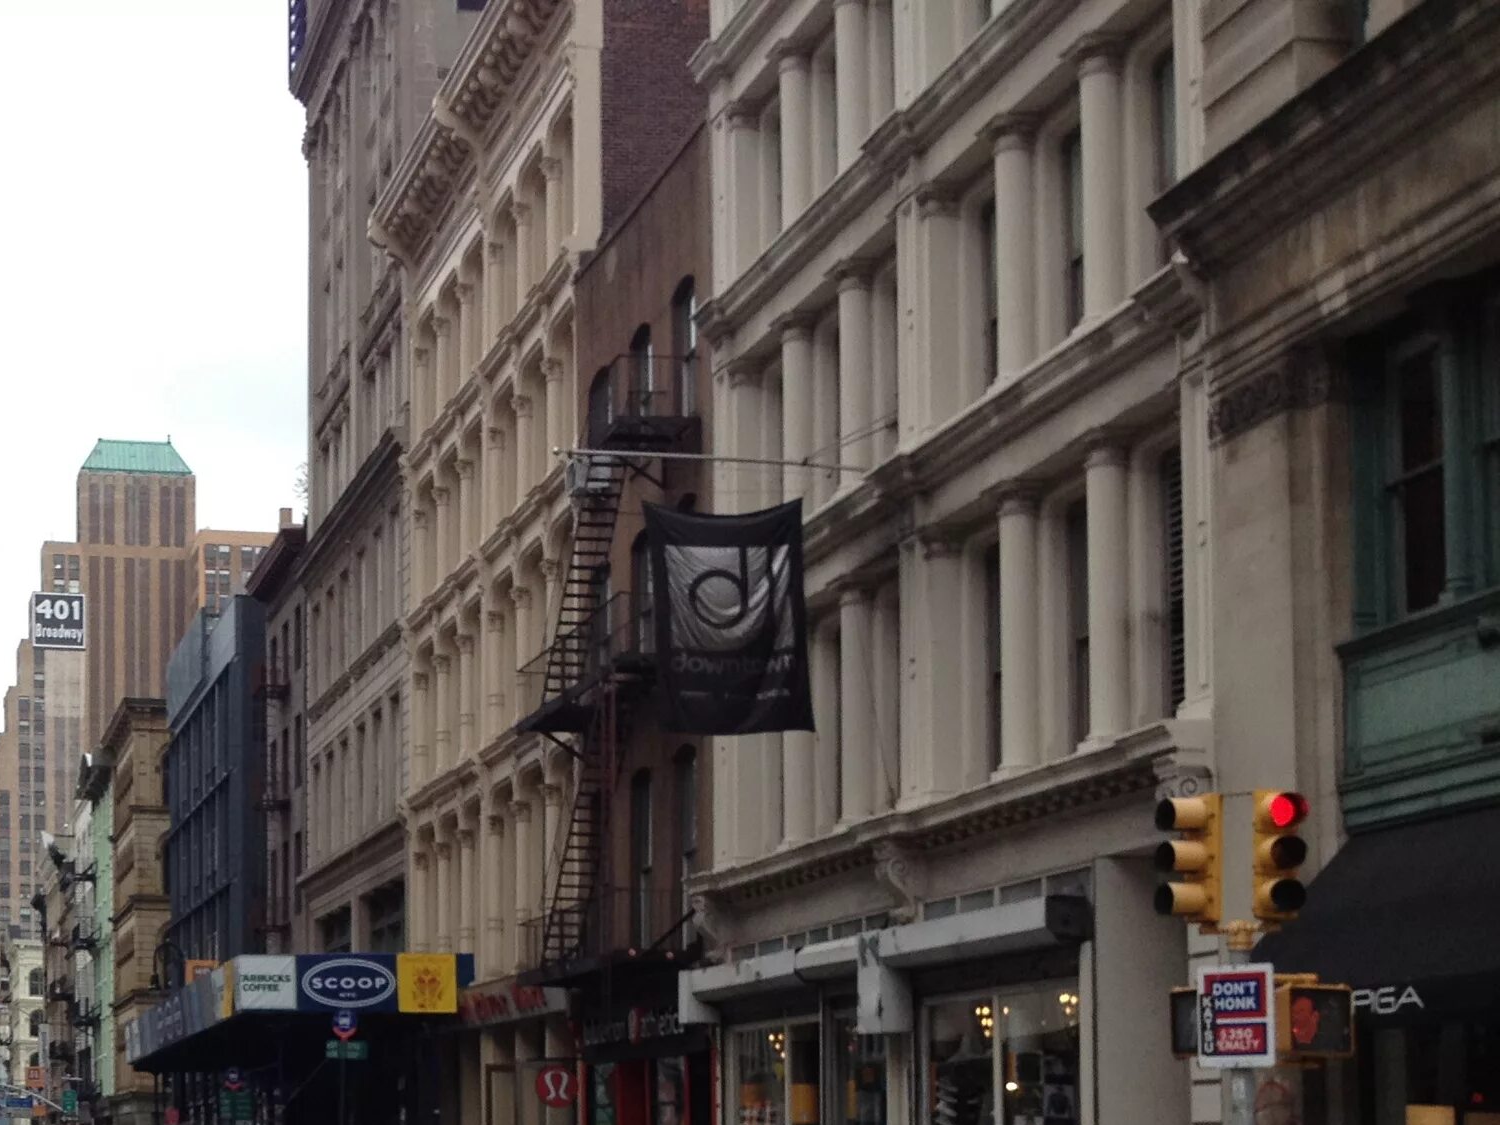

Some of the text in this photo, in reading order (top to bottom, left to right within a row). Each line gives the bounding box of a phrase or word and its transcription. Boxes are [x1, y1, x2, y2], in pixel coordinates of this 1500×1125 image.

[36, 599, 80, 620] 401
[36, 623, 82, 643] Broadway
[242, 984, 280, 993] COFFEE
[311, 976, 387, 990] SCOOP
[1212, 981, 1257, 996] DON'T
[1214, 995, 1257, 1011] HONK
